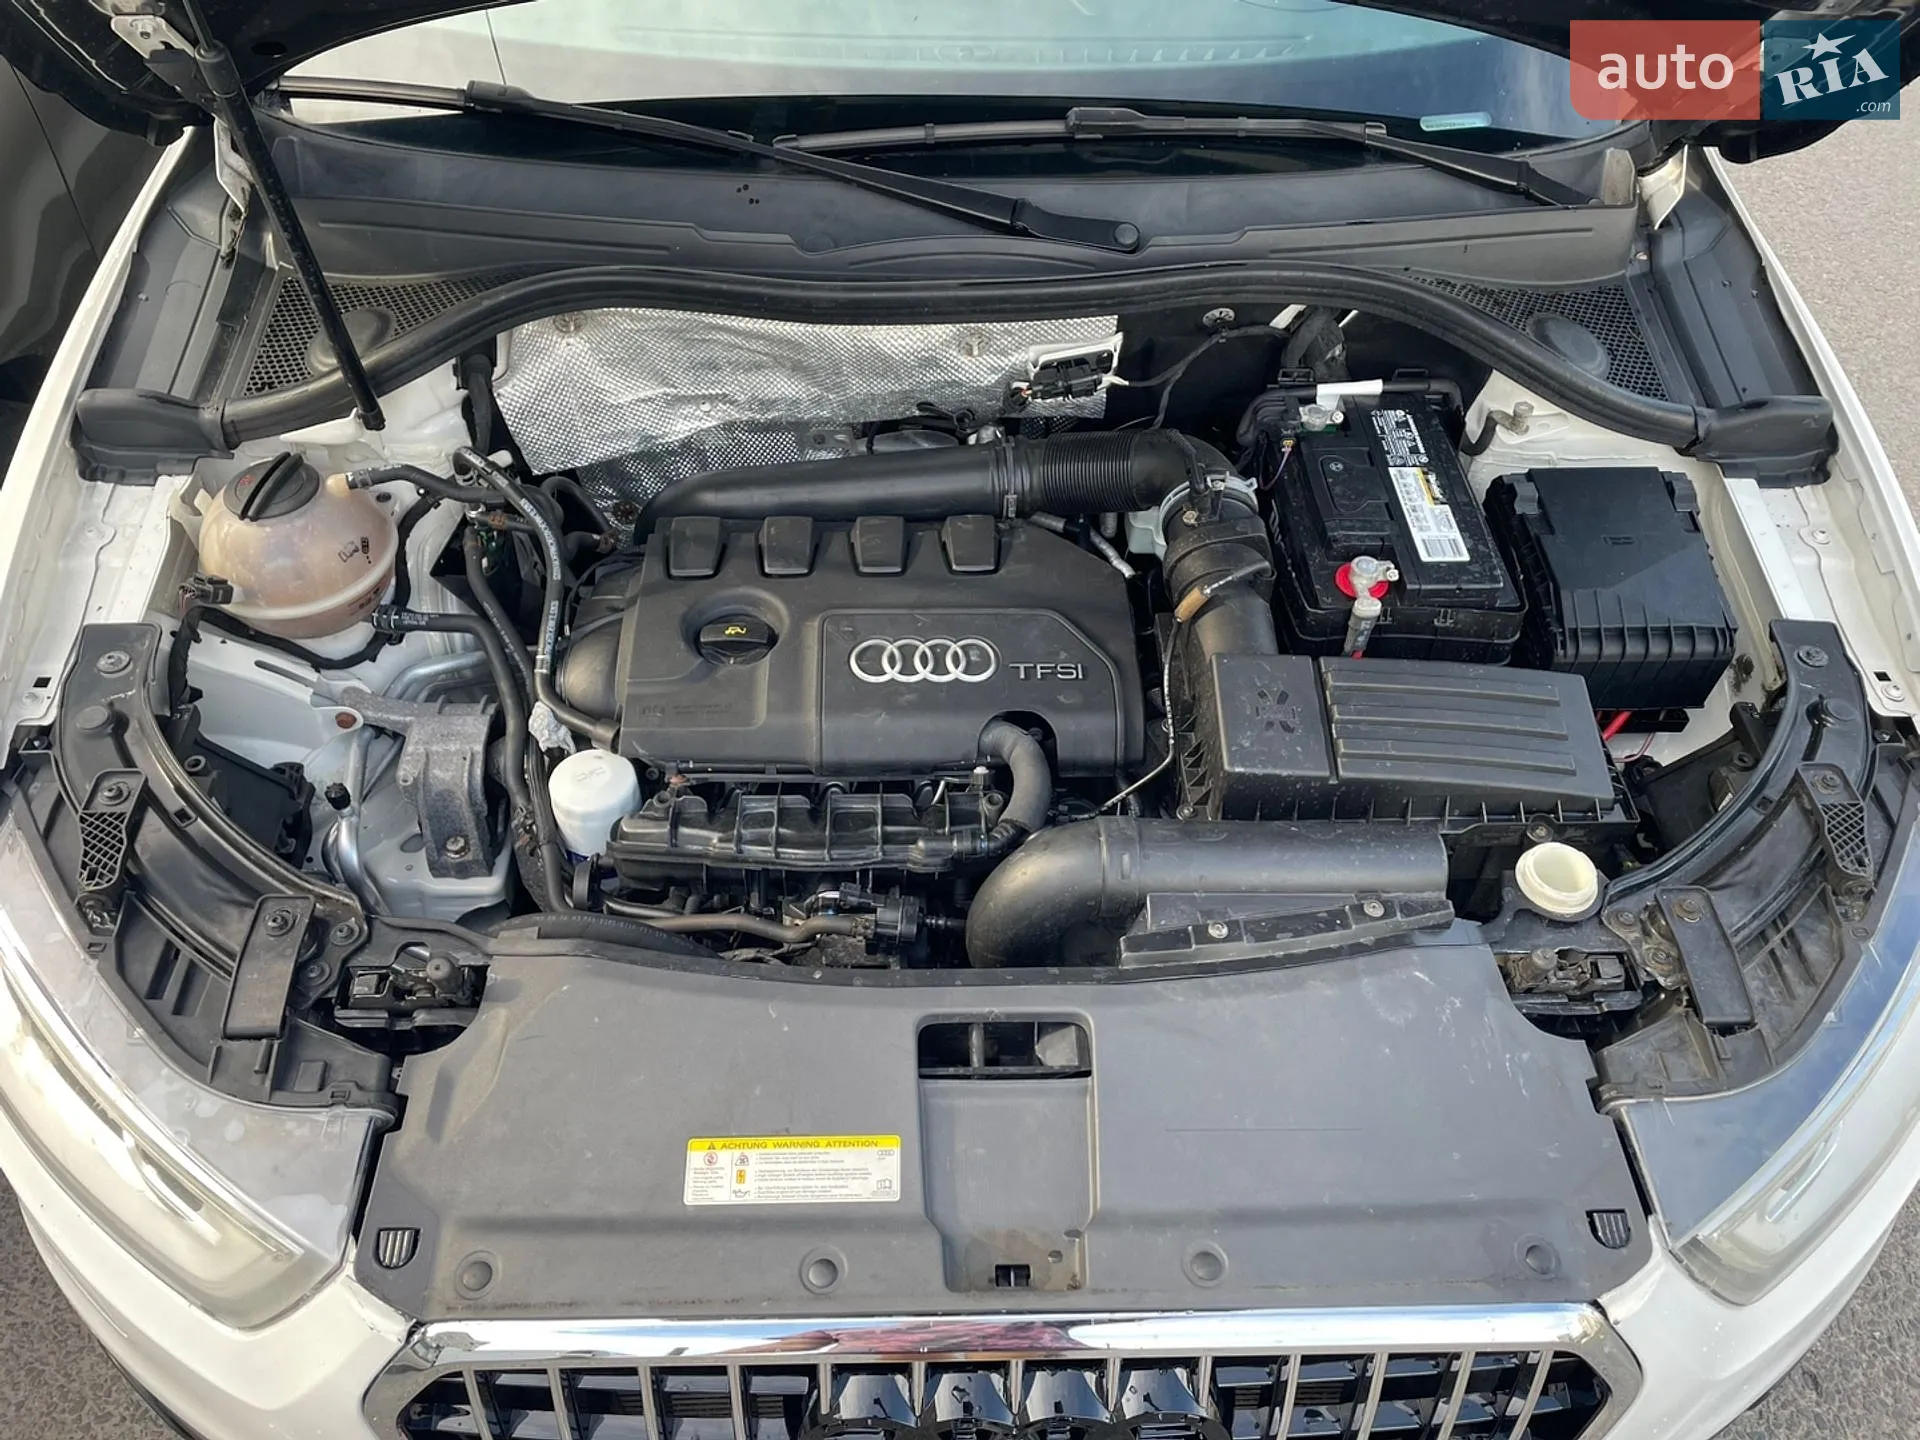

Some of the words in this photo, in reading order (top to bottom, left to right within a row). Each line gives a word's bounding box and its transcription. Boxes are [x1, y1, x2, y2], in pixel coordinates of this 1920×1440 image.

[1008, 663, 1084, 680] TFSI
[720, 1141, 768, 1150] ACHTUNG
[772, 1140, 821, 1149] WARNING
[825, 1139, 879, 1148] ATTENTION
